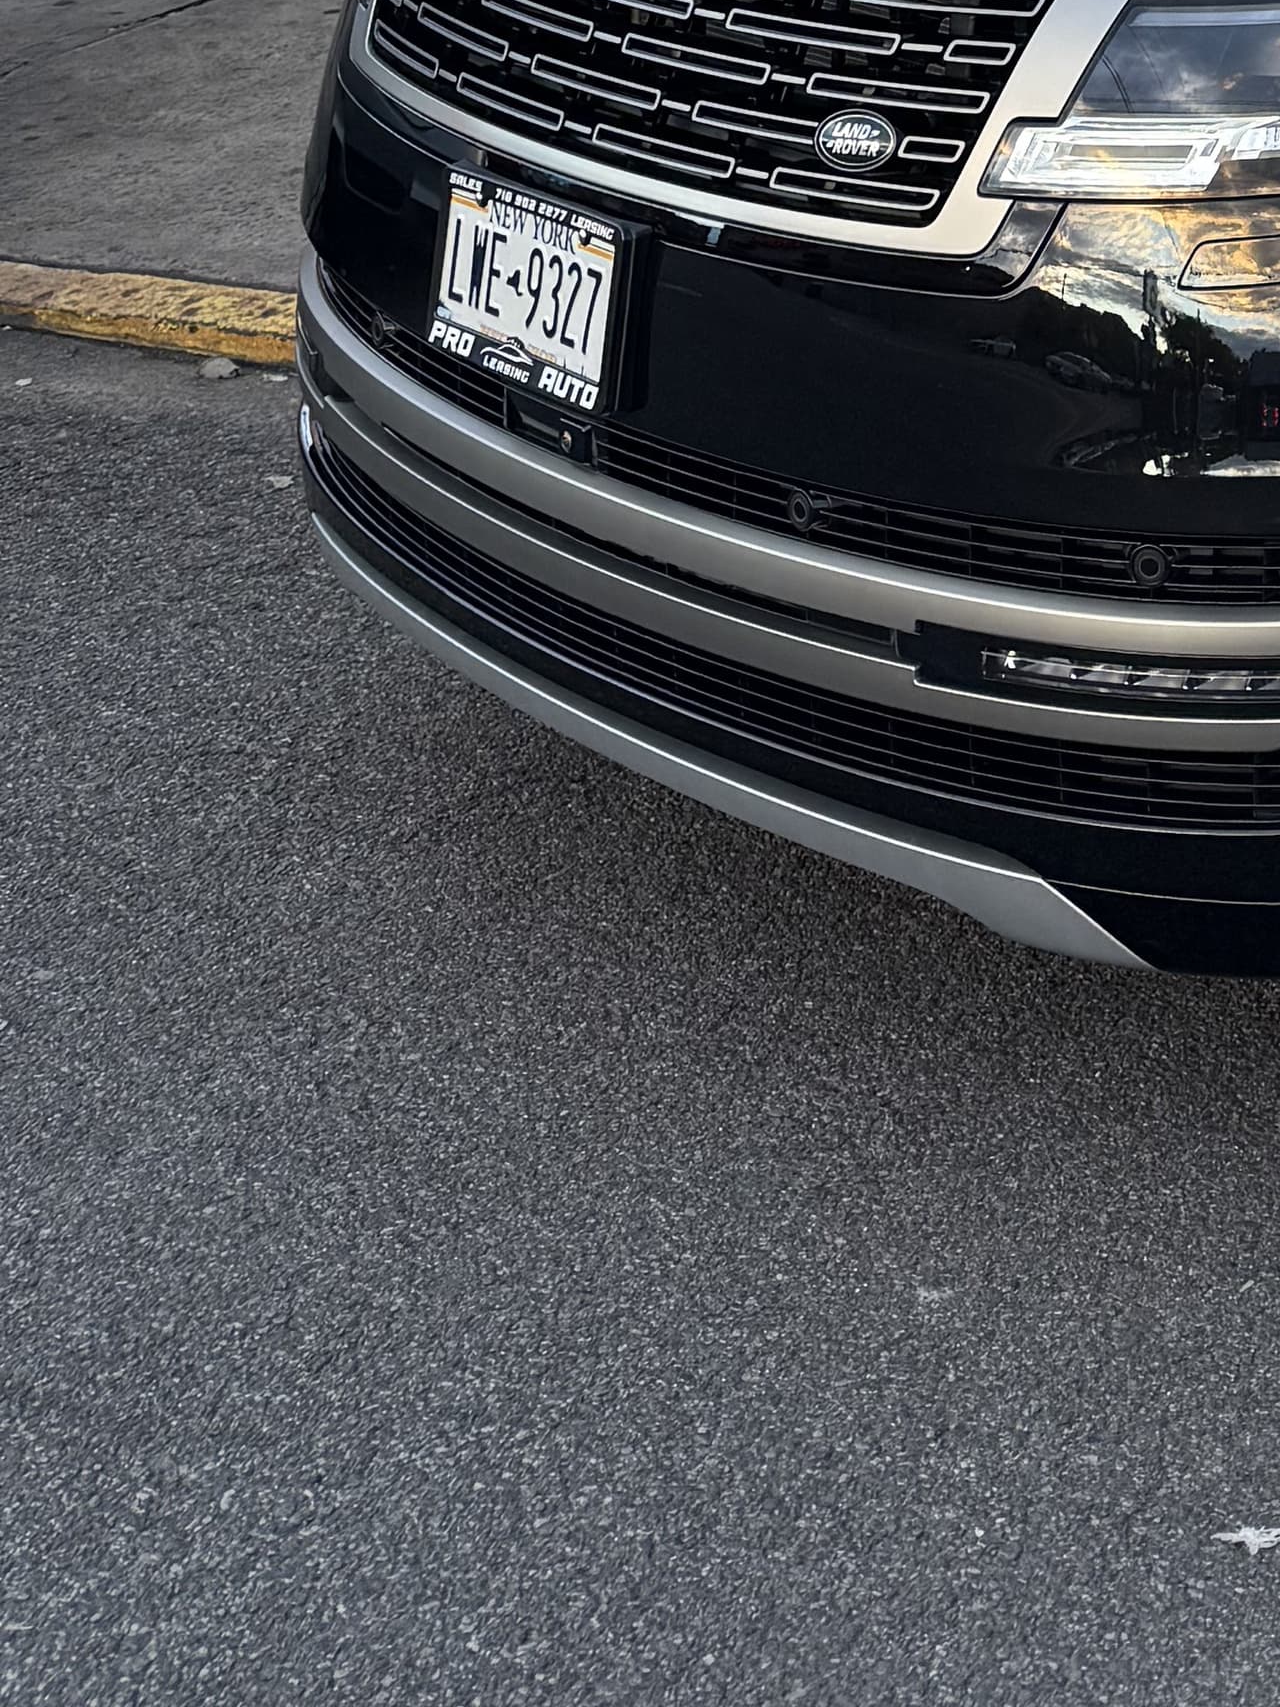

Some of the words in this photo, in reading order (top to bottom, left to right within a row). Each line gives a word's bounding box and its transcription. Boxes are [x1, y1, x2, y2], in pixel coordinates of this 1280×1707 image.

[832, 122, 872, 139] LAND
[832, 138, 880, 157] ROVER
[449, 173, 483, 192] SALES
[514, 195, 536, 211] 902
[538, 202, 568, 221] 2277
[489, 201, 527, 235] NEW
[528, 213, 579, 255] YORK
[571, 214, 615, 240] LEASING
[428, 320, 475, 358] PRO
[483, 355, 530, 384] LEASING
[538, 366, 599, 410] AUTO
